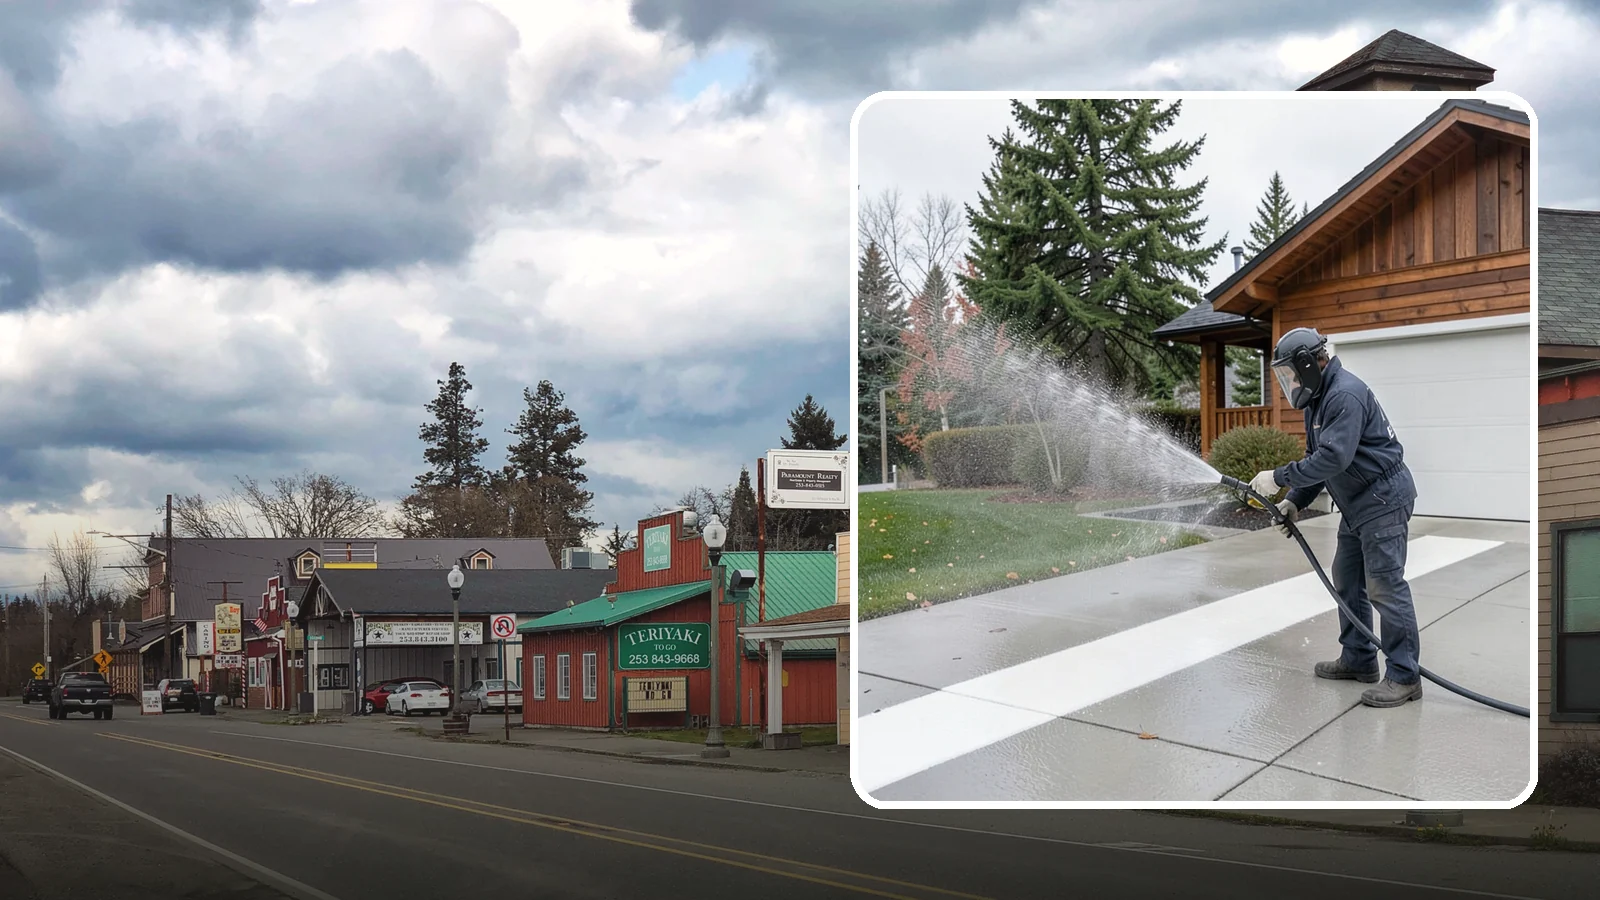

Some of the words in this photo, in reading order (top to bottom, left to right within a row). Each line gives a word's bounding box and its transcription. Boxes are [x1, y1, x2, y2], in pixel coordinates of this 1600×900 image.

[781, 471, 815, 479] PARAMOUNT
[817, 472, 839, 480] REALTY
[625, 628, 702, 645] TERIYAKI
[628, 654, 649, 665] 253
[651, 653, 700, 664] 843-9668
[639, 681, 673, 691] TERIYAKI
